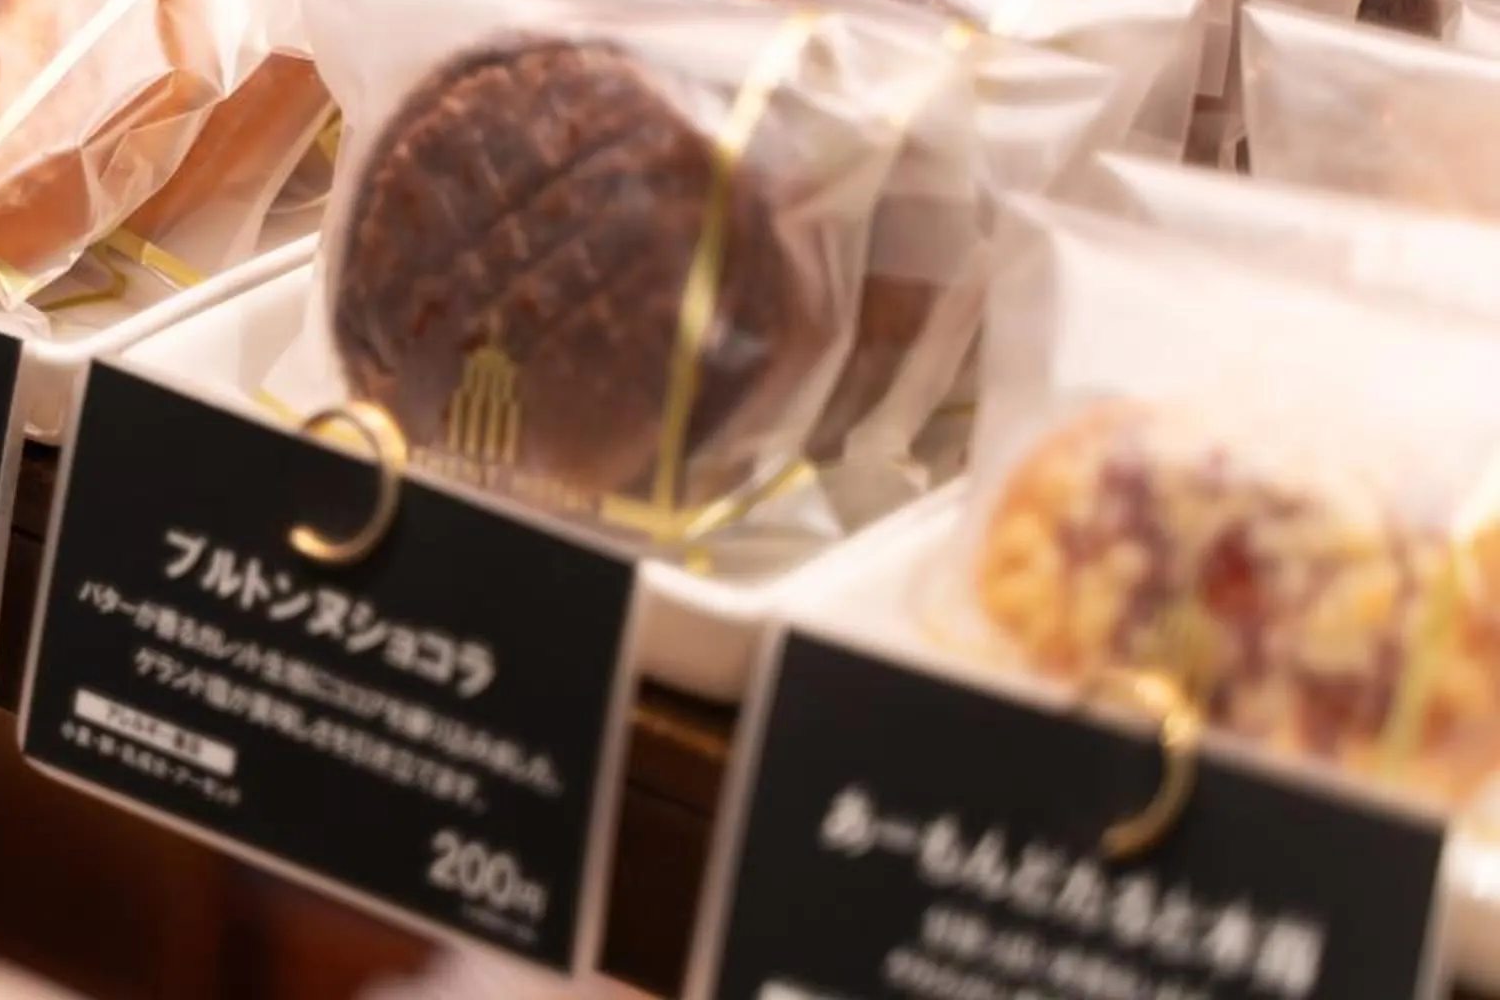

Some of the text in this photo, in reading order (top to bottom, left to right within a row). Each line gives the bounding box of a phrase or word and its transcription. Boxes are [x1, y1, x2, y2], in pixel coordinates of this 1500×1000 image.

[164, 528, 495, 697] ブルトンヌショコラ
[427, 828, 547, 919] 200円
